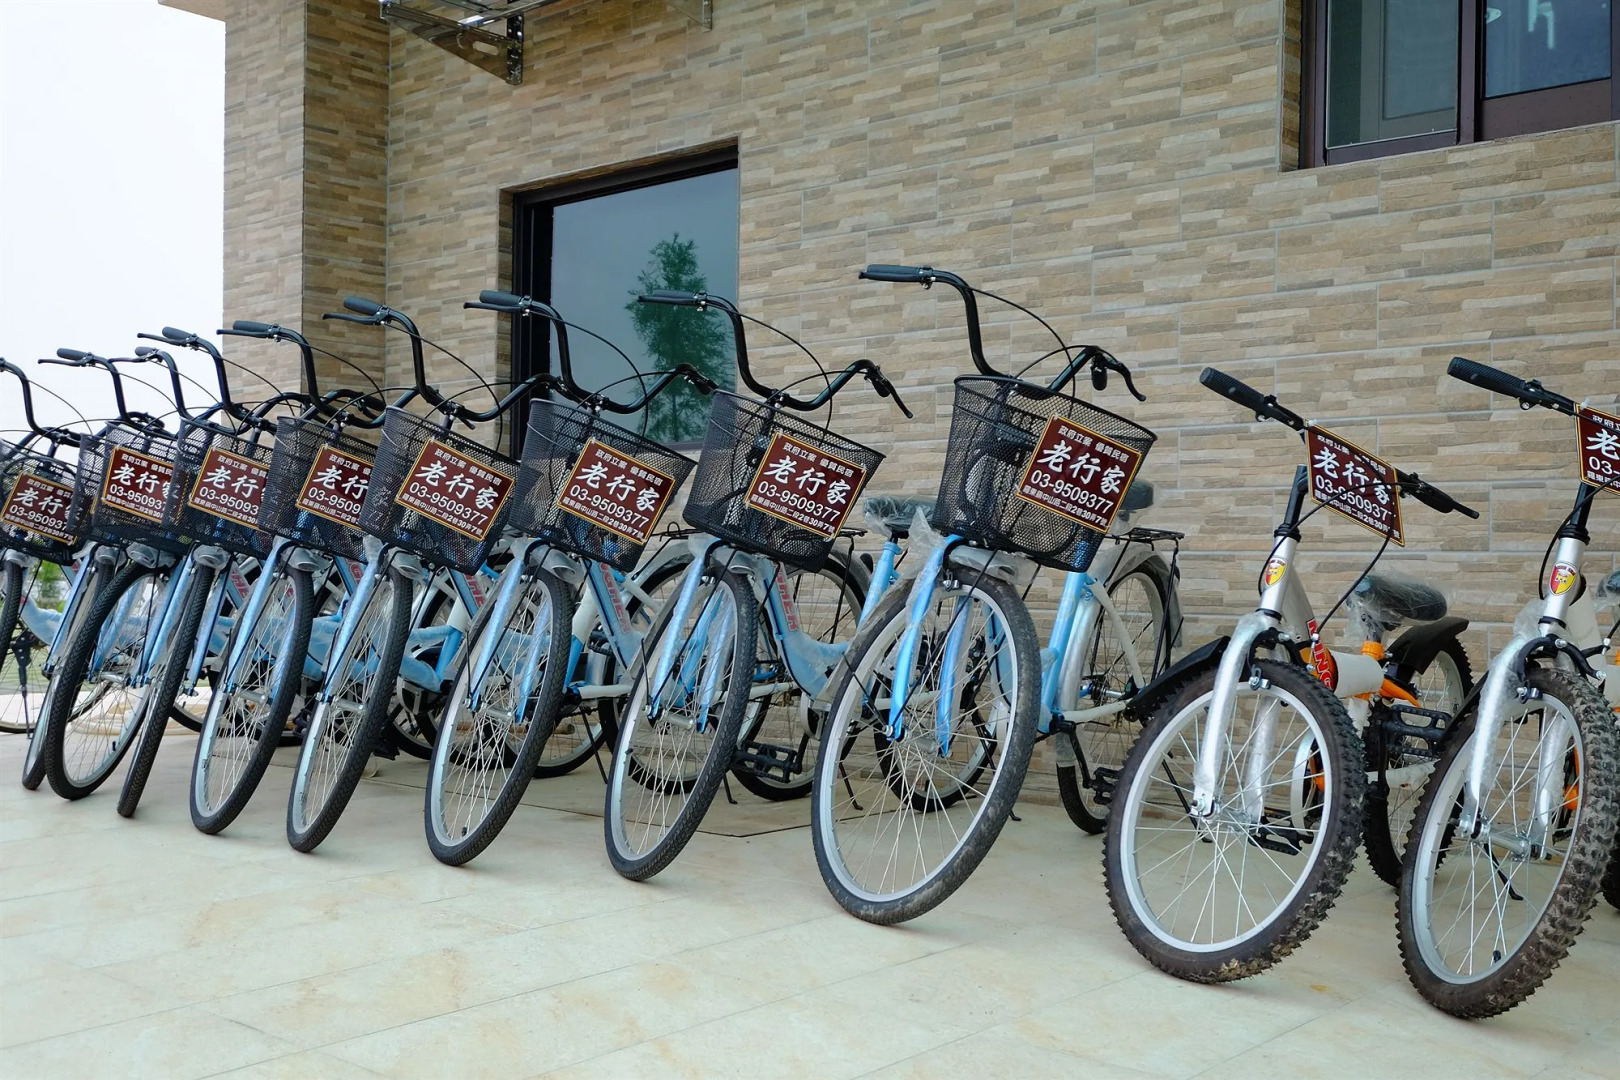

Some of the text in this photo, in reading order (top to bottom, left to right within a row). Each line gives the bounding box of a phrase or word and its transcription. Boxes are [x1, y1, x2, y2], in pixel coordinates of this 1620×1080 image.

[203, 465, 266, 501] 老行
[313, 465, 369, 500] 老行
[415, 460, 499, 510] 老行家
[576, 461, 660, 512] 老行家
[763, 455, 851, 505] 老行家
[1037, 440, 1126, 494] 老行家
[13, 487, 71, 519] 老行
[110, 484, 166, 511] 03-95093
[199, 486, 259, 516] 03-95093
[308, 487, 361, 514] 03-9509
[409, 482, 488, 525] 03-9509377
[570, 484, 650, 528] 03-9509377
[758, 481, 841, 522] 03-9509377
[1031, 470, 1114, 514] 03-9509377
